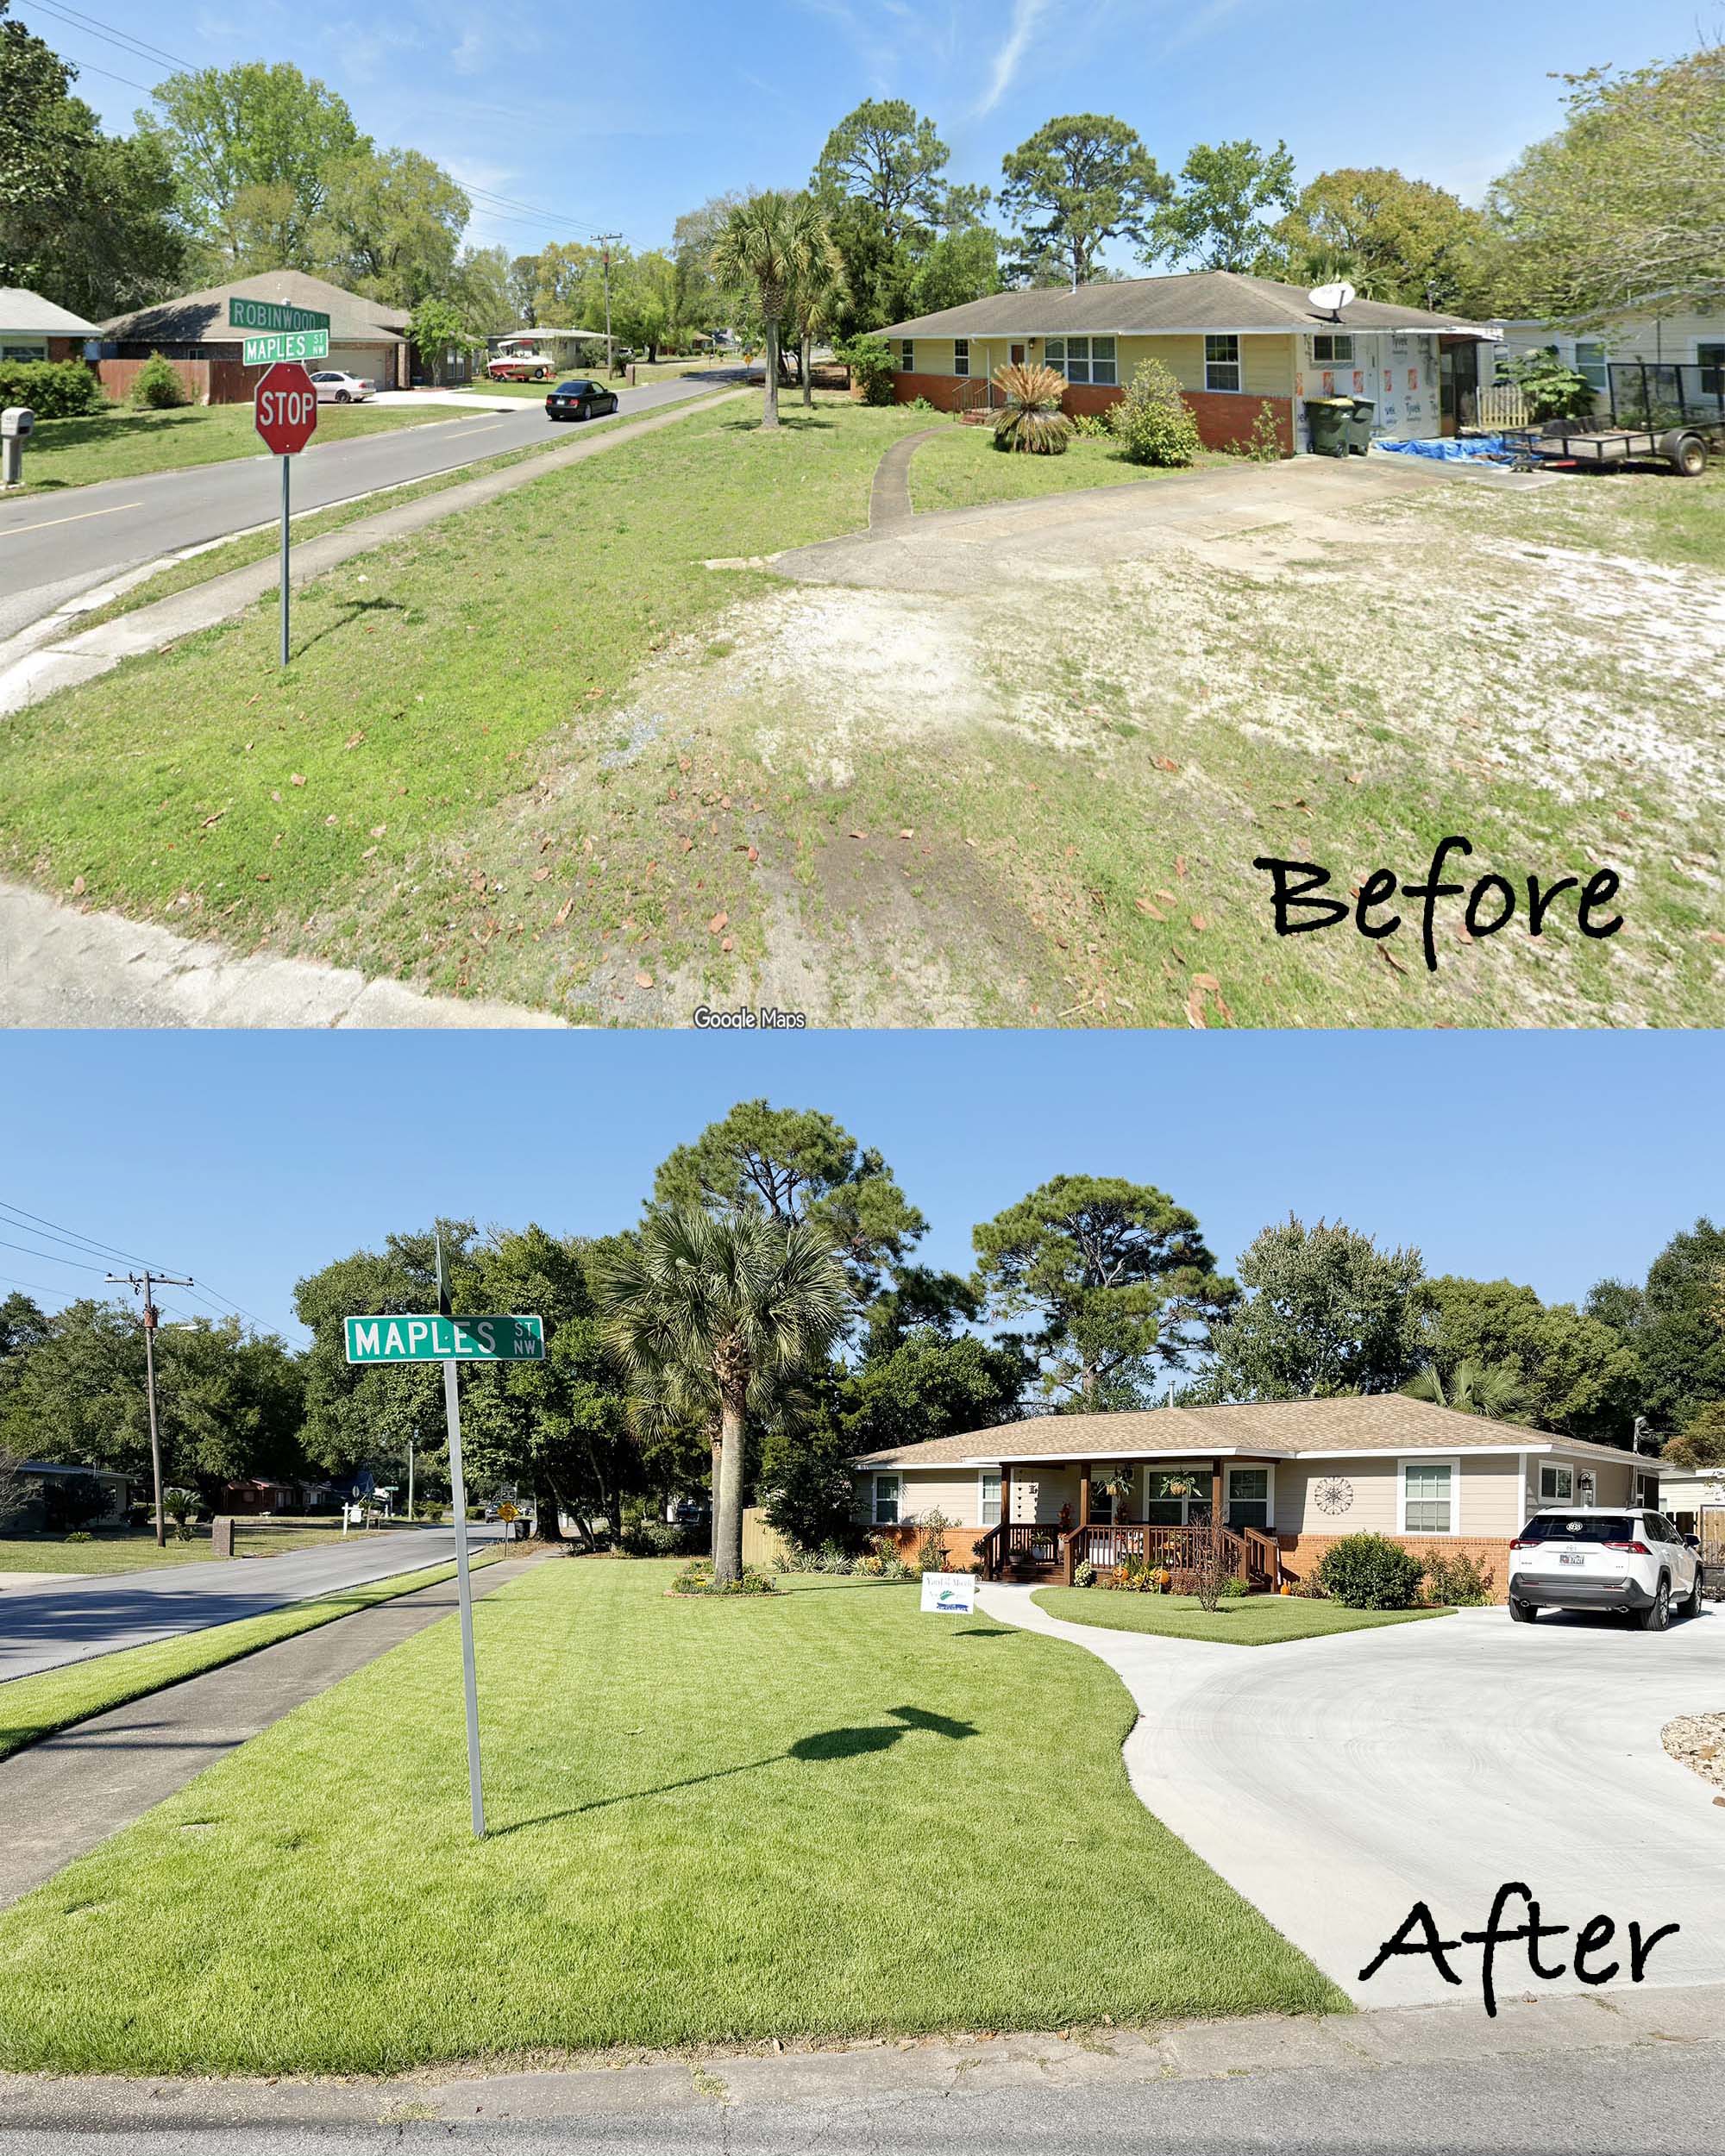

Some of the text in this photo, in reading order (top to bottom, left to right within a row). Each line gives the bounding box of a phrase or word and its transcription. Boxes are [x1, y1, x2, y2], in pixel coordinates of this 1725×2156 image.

[234, 302, 317, 331] ROBINWOOD
[248, 333, 324, 360] MAPLES ST
[313, 345, 324, 355] NW
[260, 391, 315, 427] STOP
[354, 1321, 535, 1357] MAPLES ST
[513, 1339, 536, 1355] NW
[502, 1491, 516, 1500] 25
